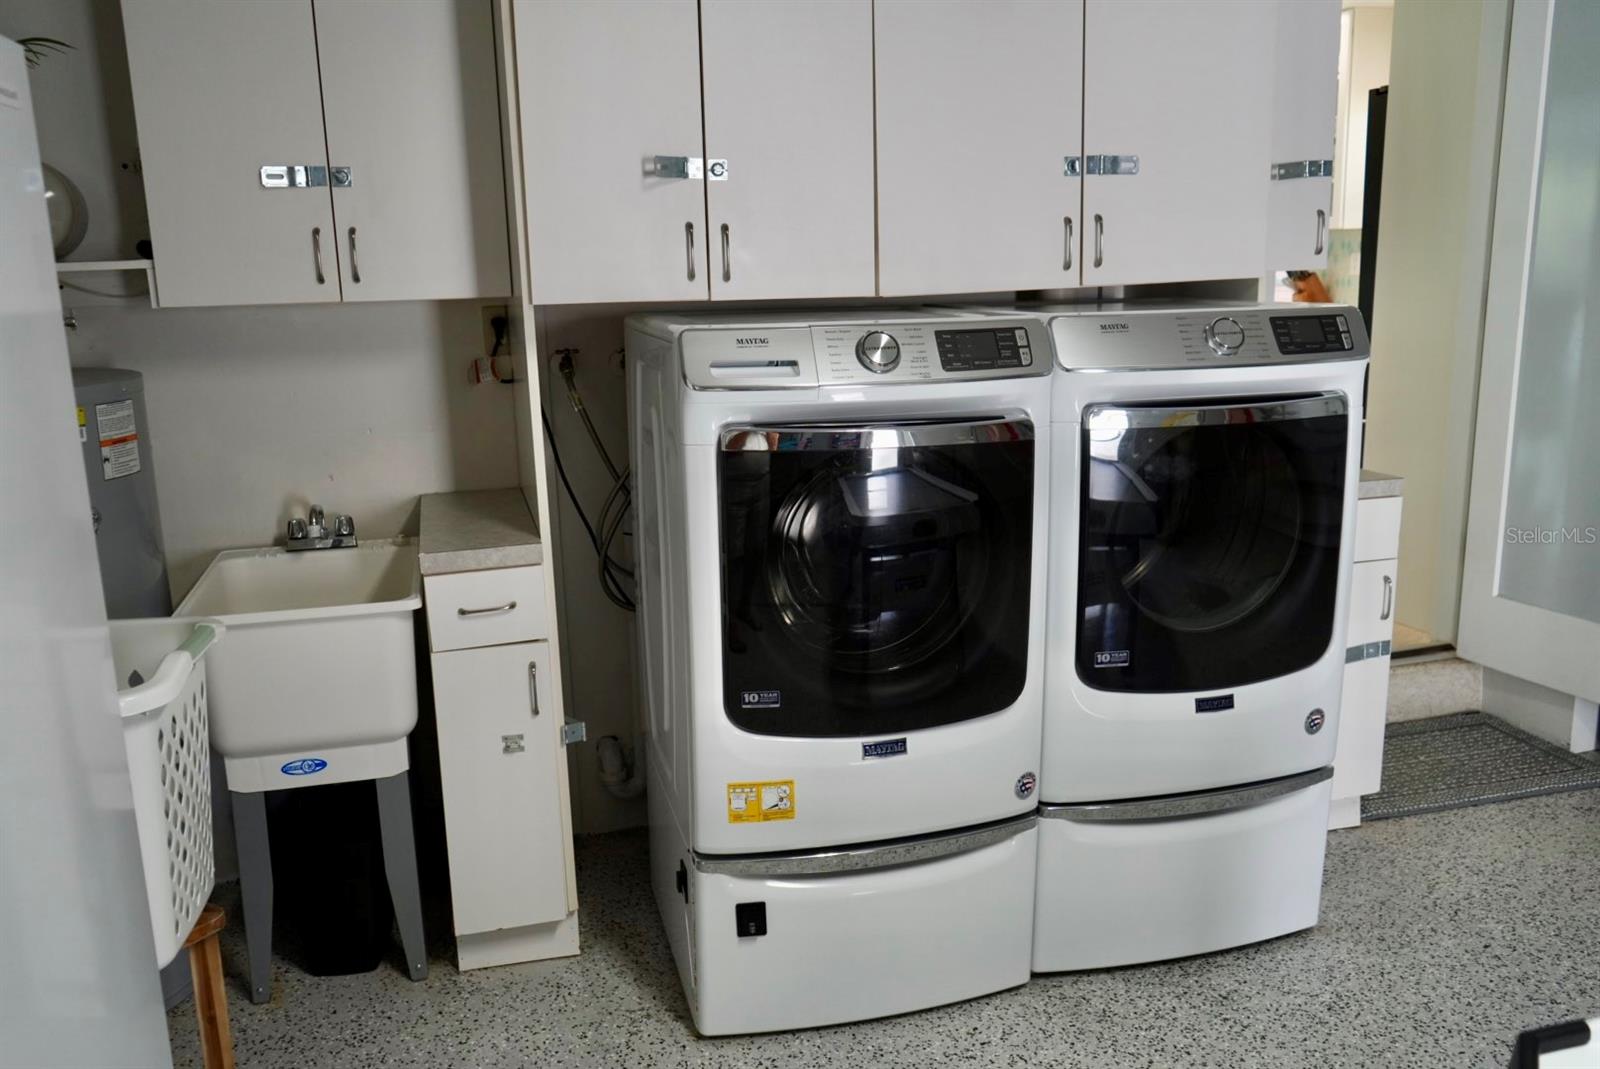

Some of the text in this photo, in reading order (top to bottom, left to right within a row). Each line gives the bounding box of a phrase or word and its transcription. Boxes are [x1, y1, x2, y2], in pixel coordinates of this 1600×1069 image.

[1097, 654, 1110, 663] 10
[743, 693, 759, 703] 10
[864, 742, 905, 756] MAYTAG
